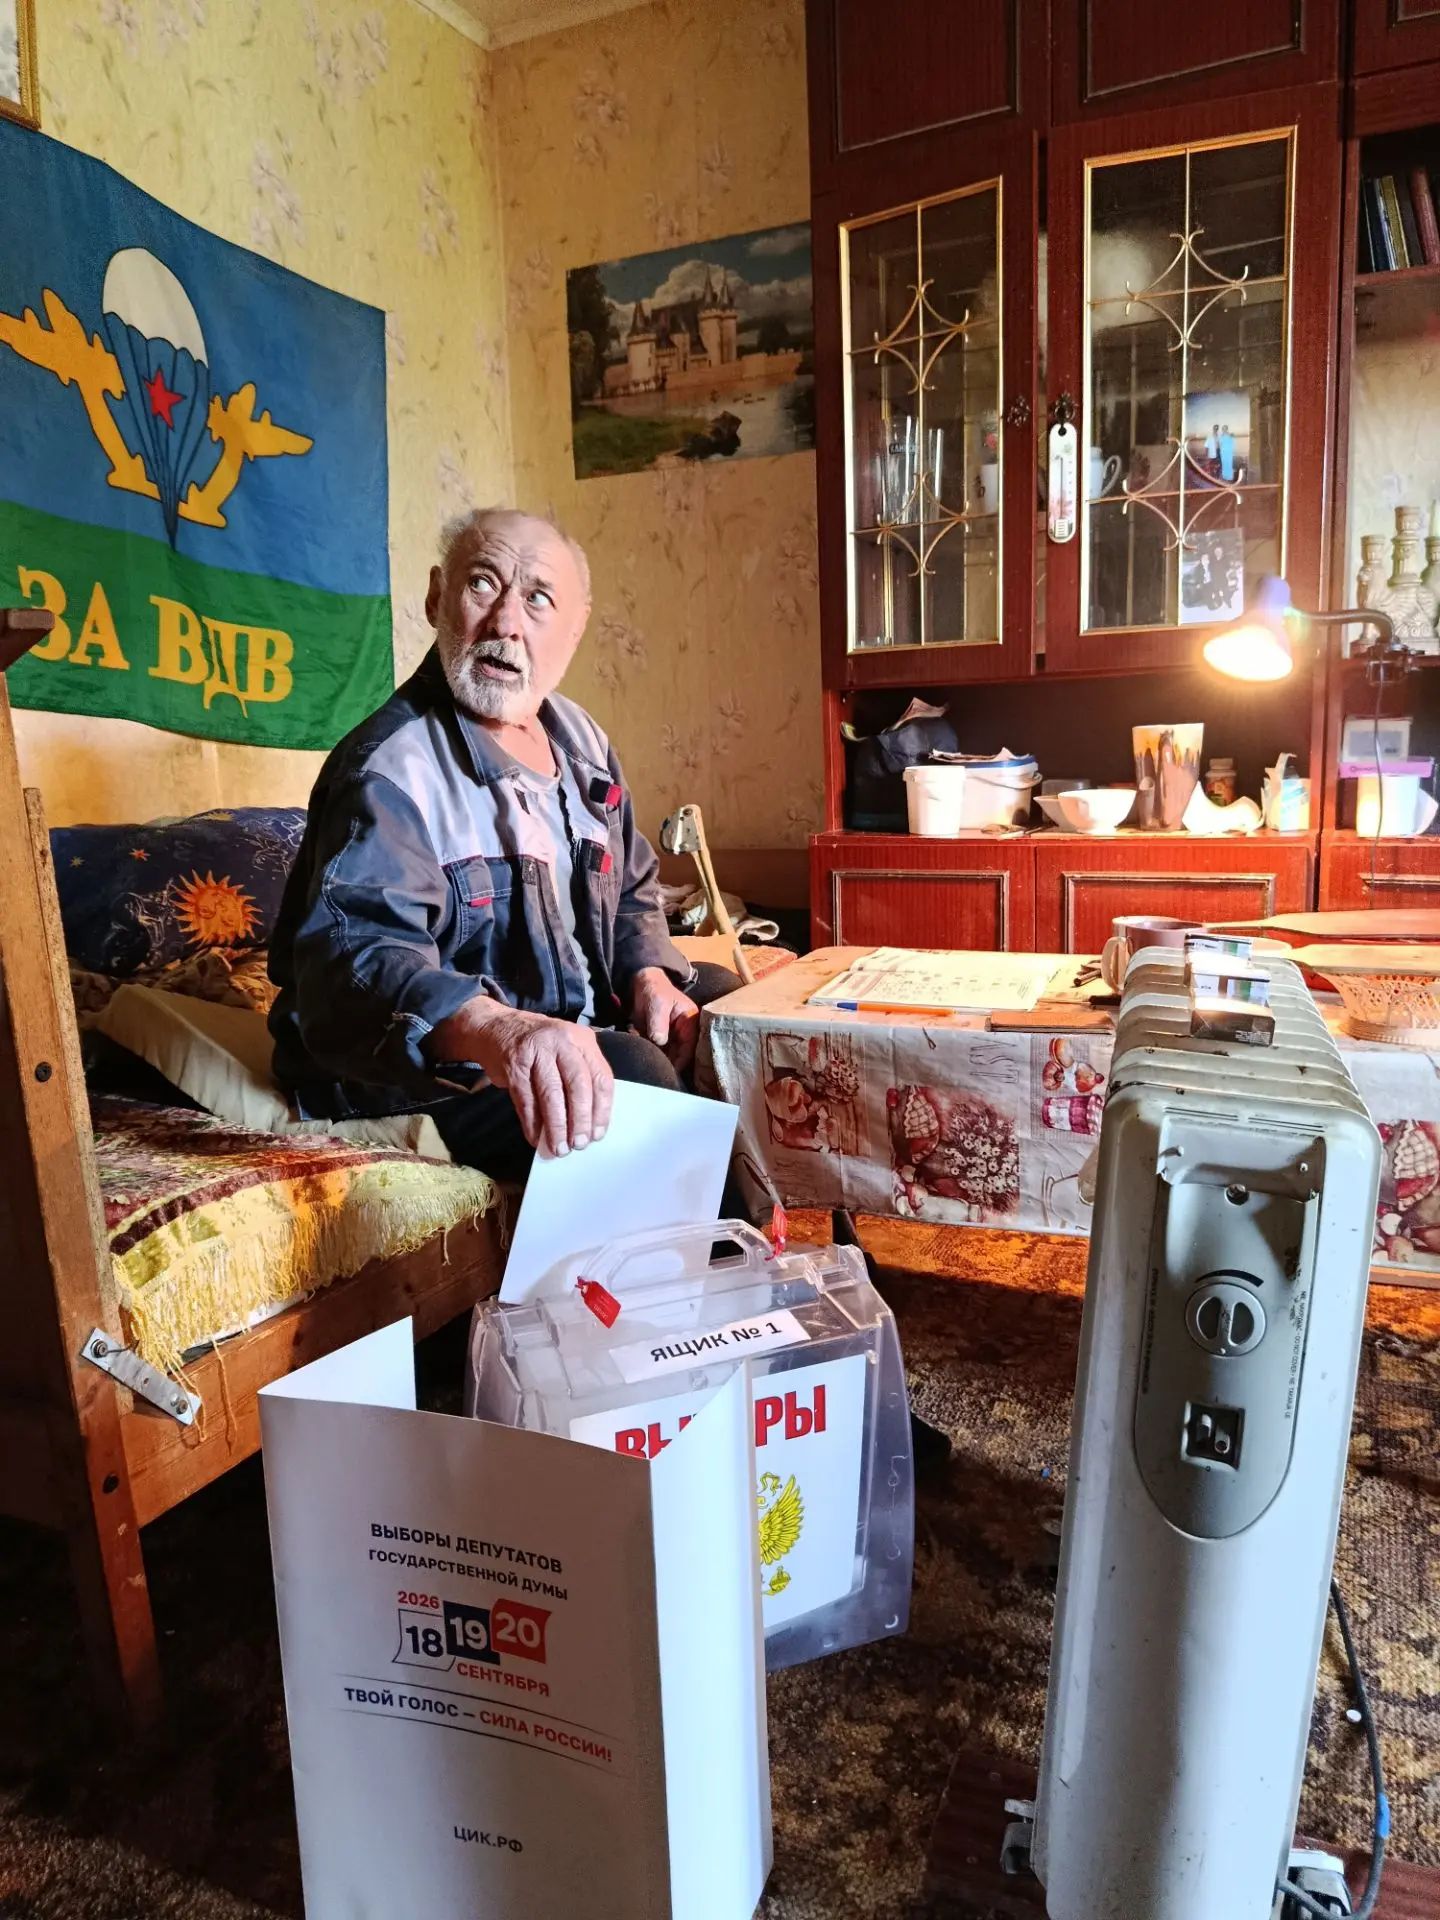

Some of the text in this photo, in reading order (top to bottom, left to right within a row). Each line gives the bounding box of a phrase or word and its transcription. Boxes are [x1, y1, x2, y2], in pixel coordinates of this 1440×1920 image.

[18, 565, 294, 718] ЗА ВДВ
[650, 1322, 782, 1362] ЯЩИК № 1
[371, 1523, 563, 1574] ВЫБОРЫ ДЕПУТАТОВ
[369, 1549, 568, 1600] ГОСУДАРСТВЕННОЙ ДУМЫ
[398, 1591, 440, 1610] 2026
[405, 1612, 541, 1658] 18 19 20
[457, 1662, 550, 1697] СЕНТЯБРЯ
[344, 1687, 394, 1706] ТВОЙ
[398, 1694, 458, 1717] ГОЛОС
[479, 1710, 529, 1734] СИЛА
[533, 1724, 613, 1762] РОССИИ!
[453, 1825, 523, 1853] ЦИК.РФ
